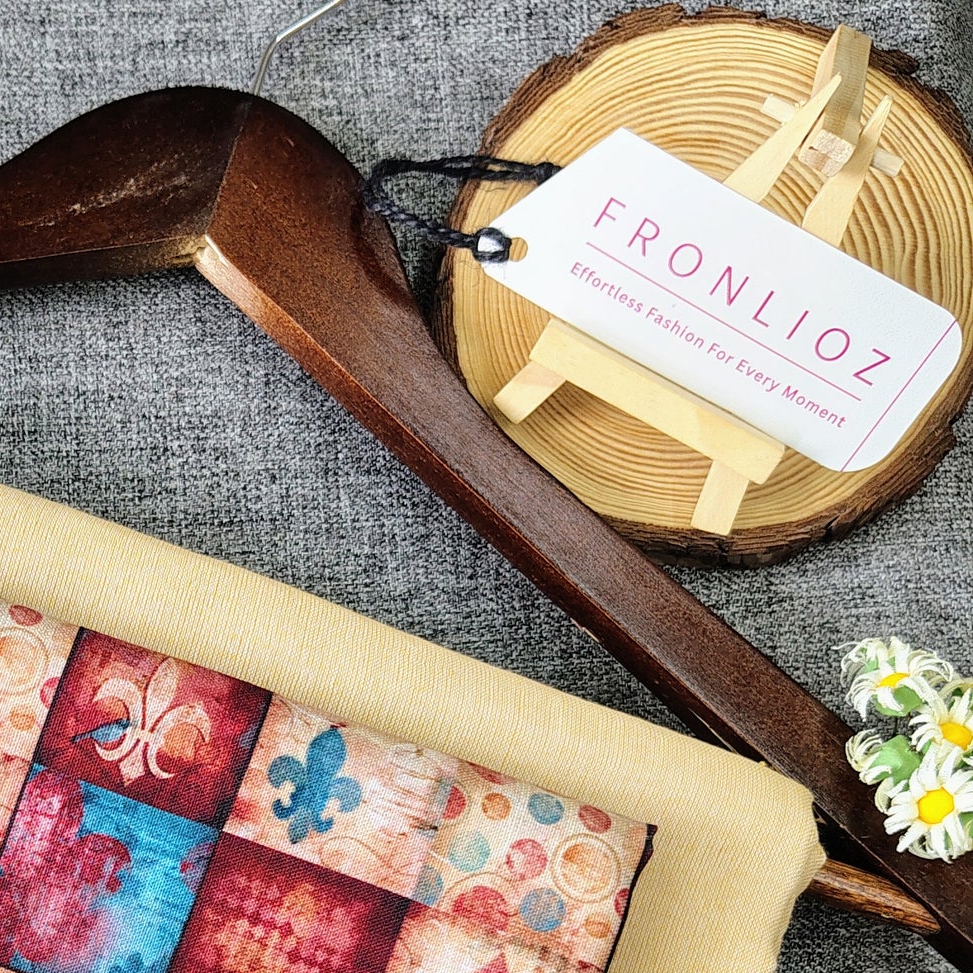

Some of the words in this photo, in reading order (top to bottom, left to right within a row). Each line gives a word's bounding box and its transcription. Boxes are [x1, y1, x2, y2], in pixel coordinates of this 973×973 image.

[570, 262, 643, 313] Effortless
[646, 307, 704, 349] Fashion
[707, 343, 734, 364] For
[735, 359, 780, 392] Every
[781, 385, 846, 428] Moment
[593, 197, 891, 386] FRONLIOZ
